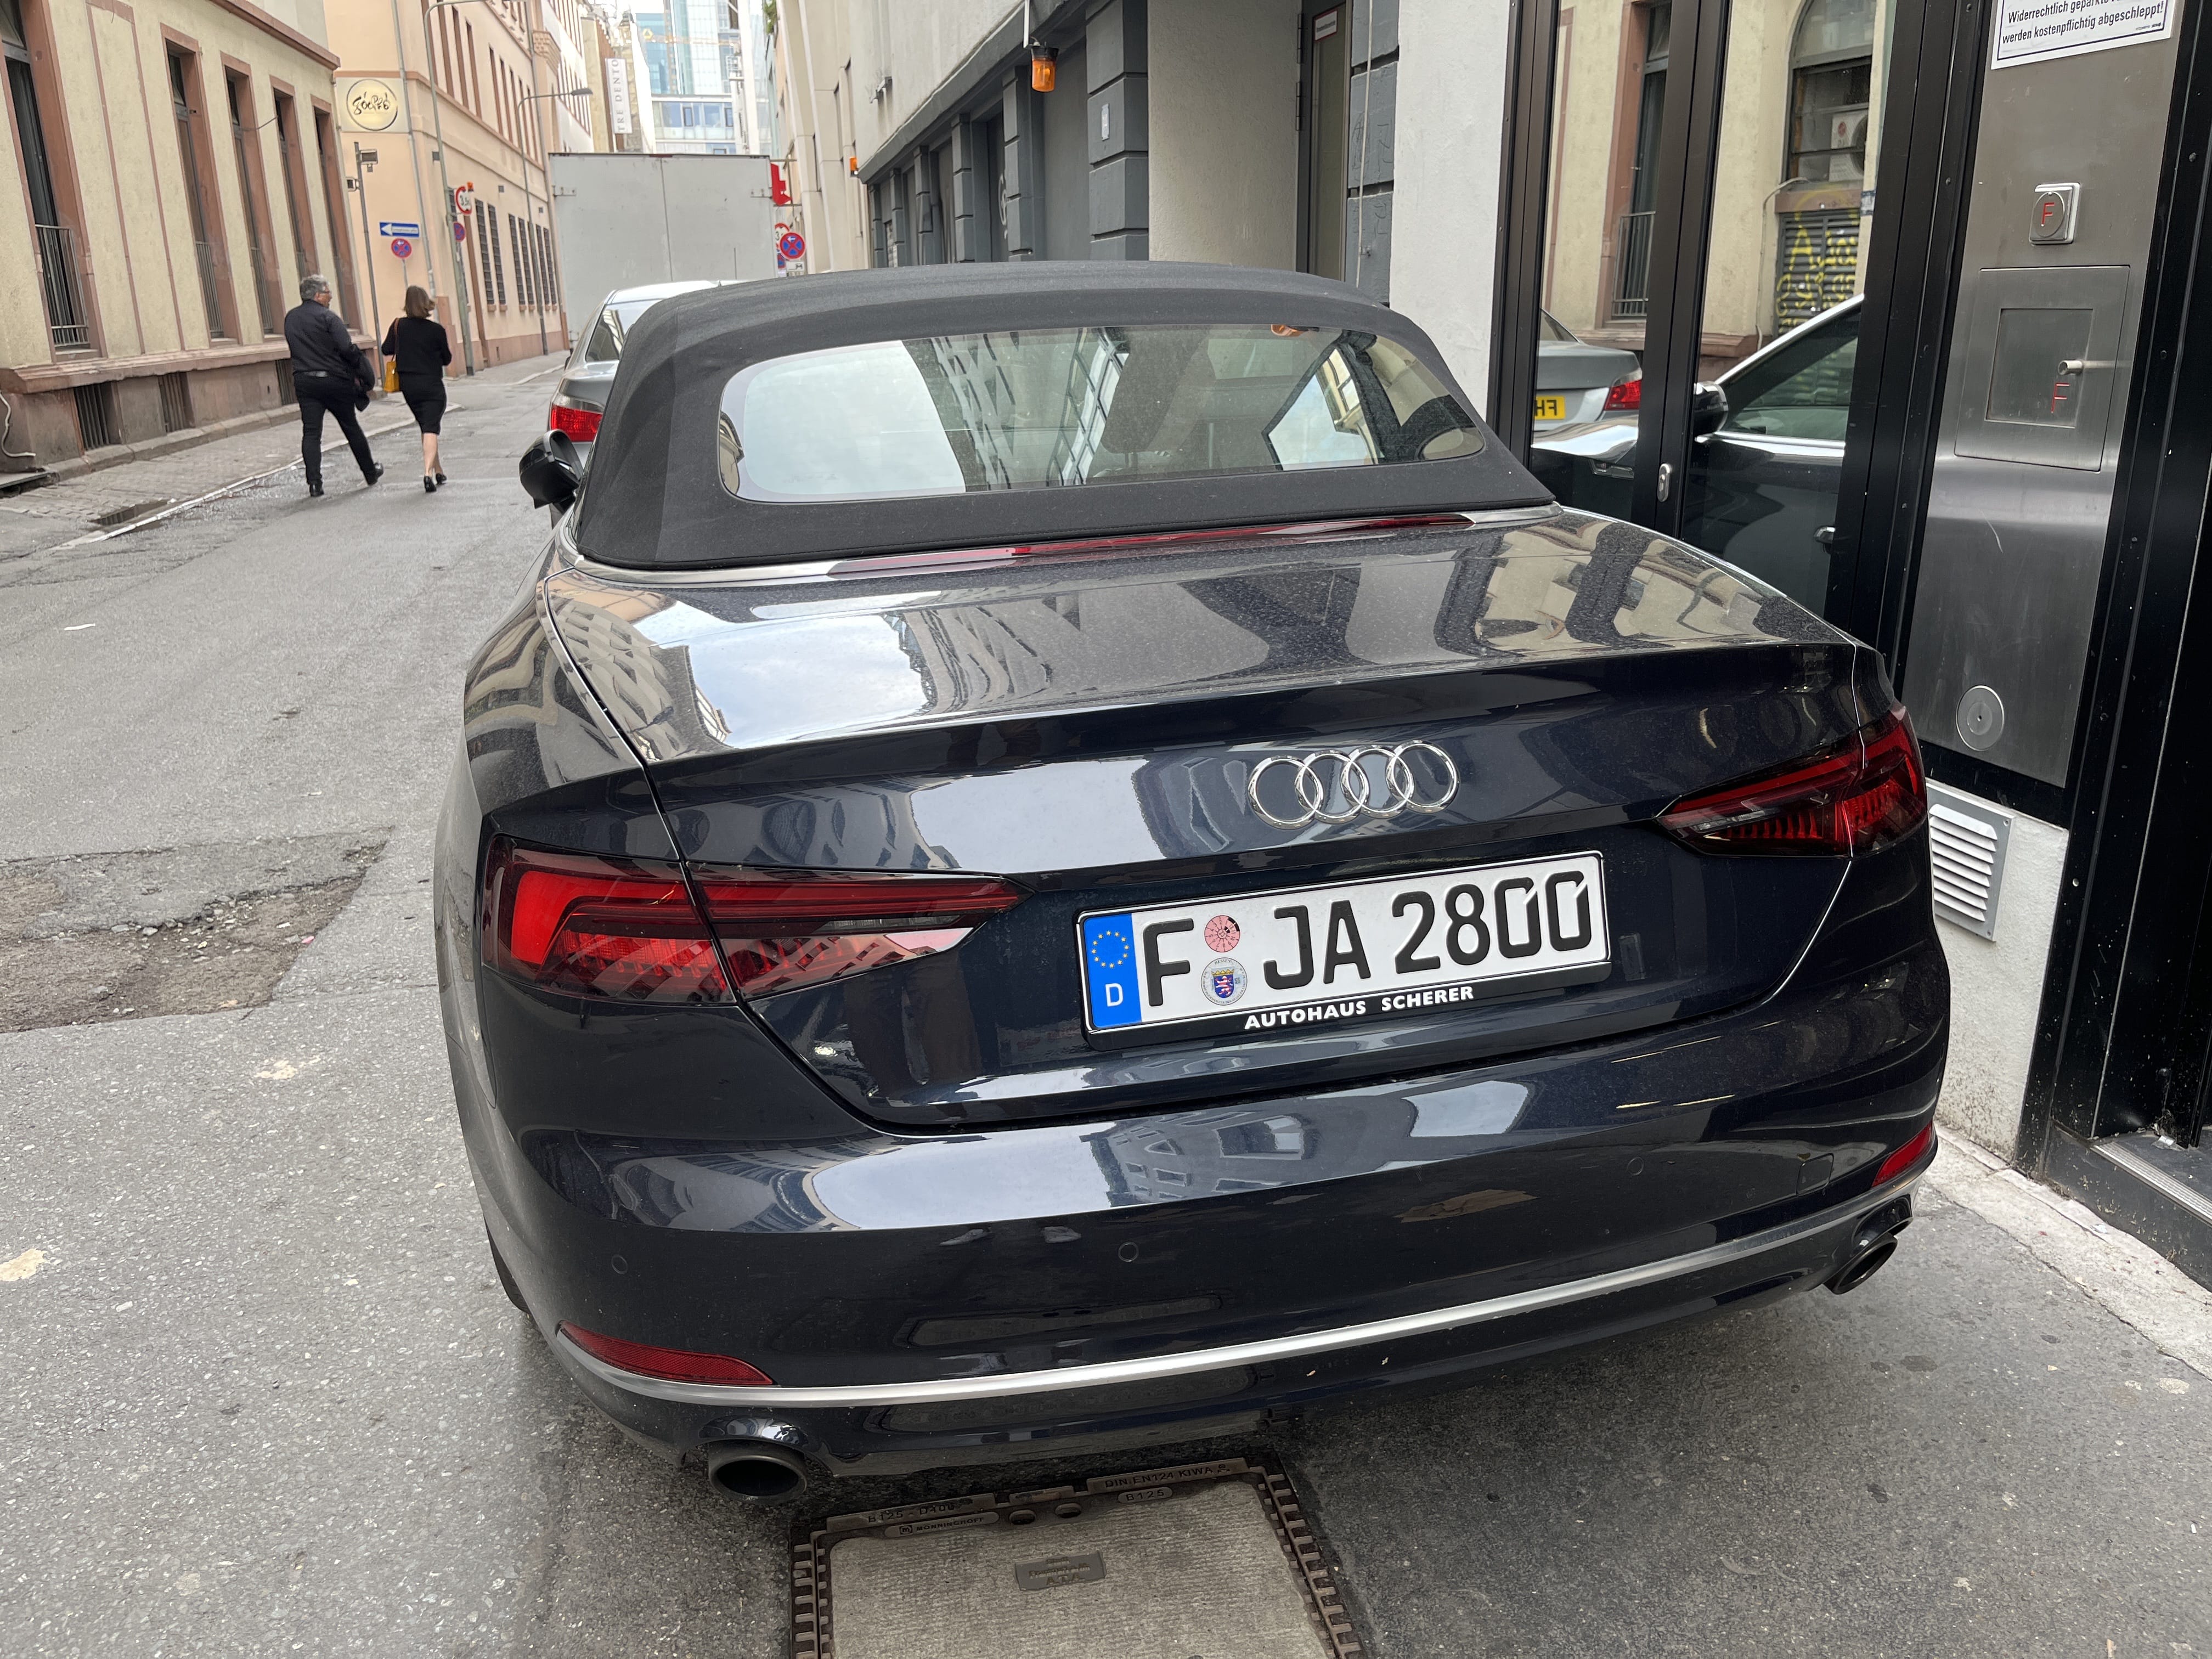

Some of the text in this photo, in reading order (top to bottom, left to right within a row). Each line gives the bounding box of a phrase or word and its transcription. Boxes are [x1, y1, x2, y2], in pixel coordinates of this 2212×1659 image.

[2002, 1, 2164, 44] werden kostenpflichtig abgeschleppt!
[2008, 1, 2068, 23] Widerrechtlich
[611, 59, 625, 132] TRE DENTO
[2041, 202, 2055, 227] F
[2051, 382, 2070, 414] F
[1143, 871, 1592, 1007] F JA 2800
[1105, 983, 1124, 1007] D
[1244, 986, 1474, 1030] AUTOHAUS SCHERER
[1179, 1466, 1213, 1477] KIWA
[1126, 1489, 1164, 1501] B125
